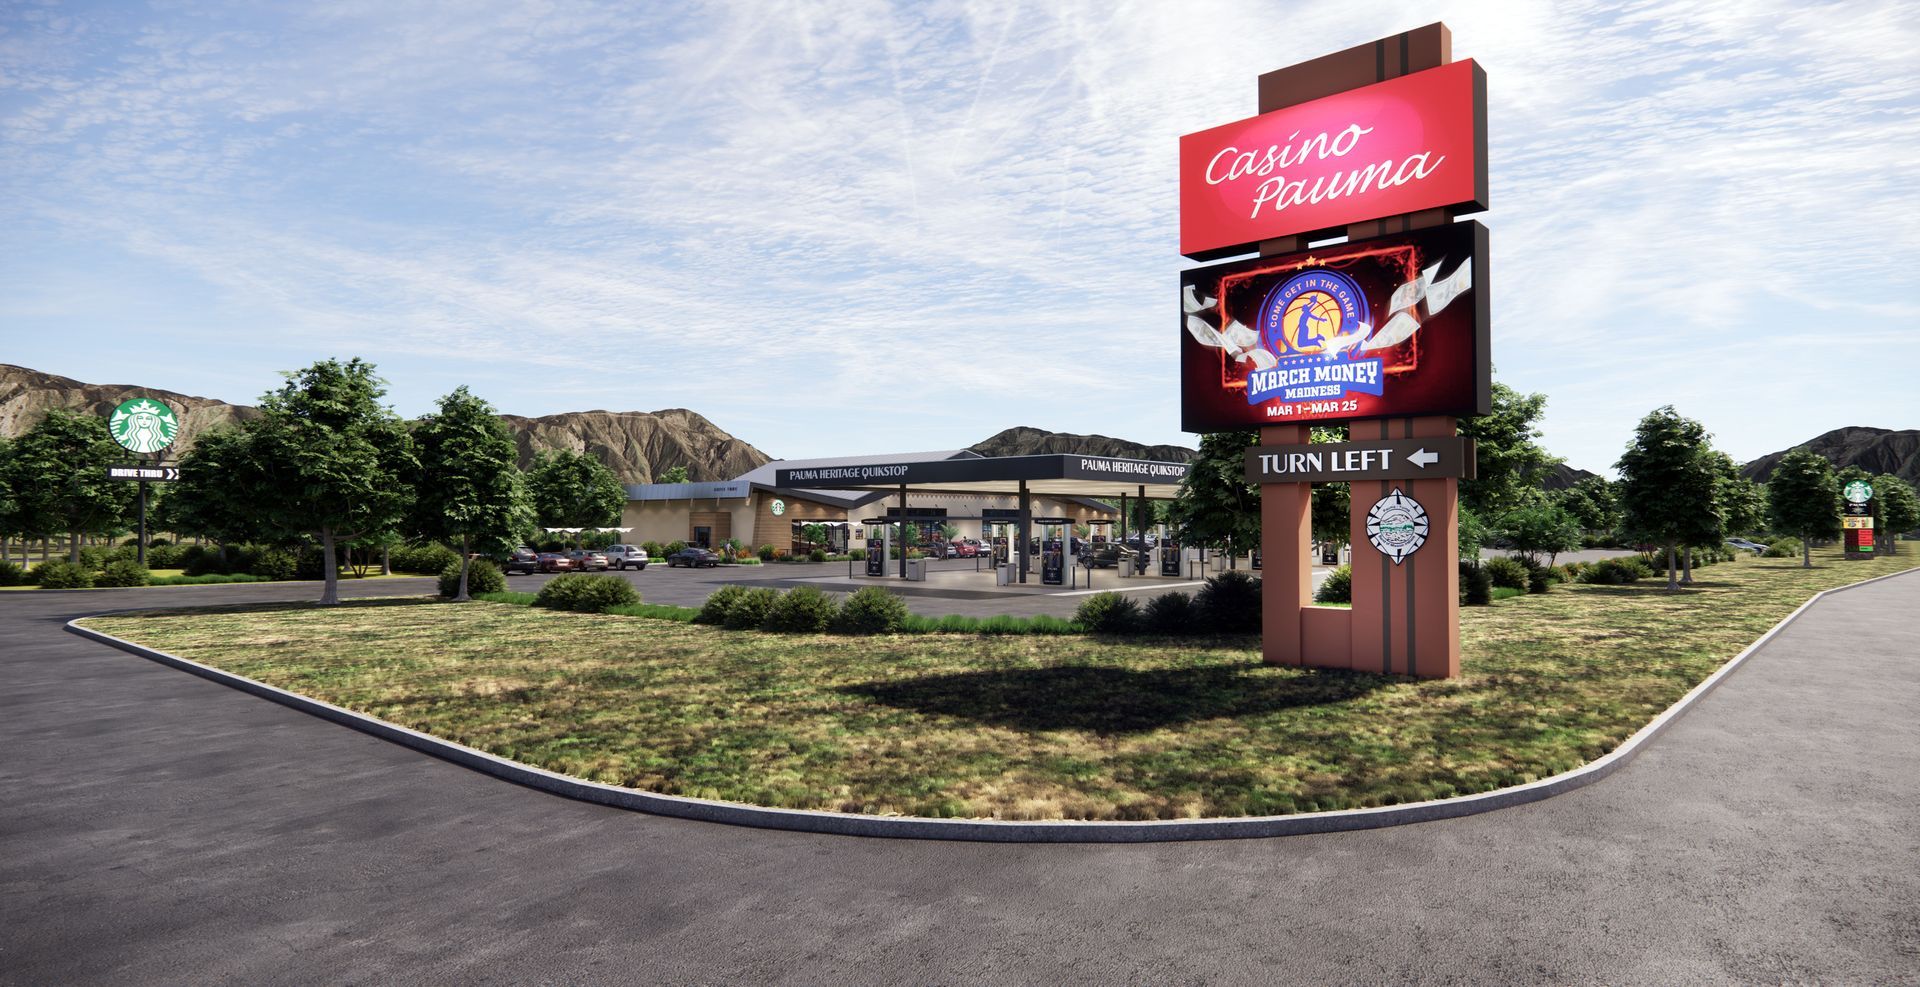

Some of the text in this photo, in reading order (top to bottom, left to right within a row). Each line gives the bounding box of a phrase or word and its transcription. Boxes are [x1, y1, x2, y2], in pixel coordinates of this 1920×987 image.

[1205, 124, 1374, 185] Casino
[1250, 151, 1446, 219] Pauma
[1270, 279, 1355, 327] COME GET IN THE GAME
[1251, 361, 1378, 395] MARCH MONEY
[1285, 384, 1341, 399] MADNESS
[1267, 406, 1293, 416] MAR
[1341, 400, 1357, 411] 25
[1081, 459, 1185, 477] PAUMA HERITAGE QUIKSTOP
[1258, 449, 1393, 474] TURN LEFT
[111, 468, 163, 478] DRIVE THRU
[789, 465, 908, 480] PAUMA HERITAGE QUIKSTOP
